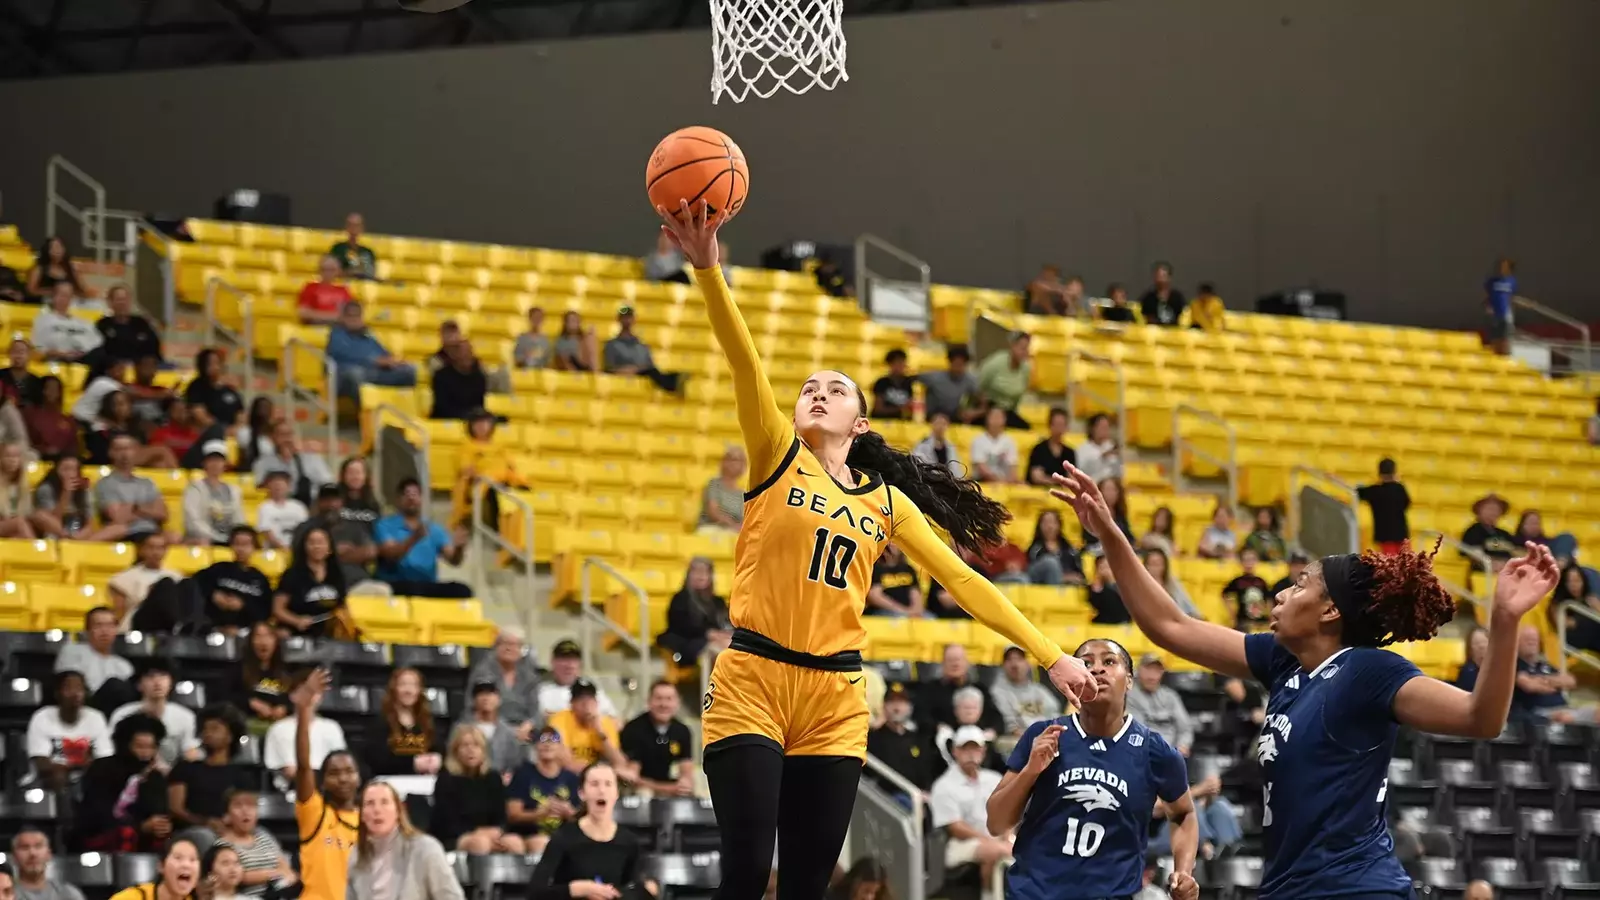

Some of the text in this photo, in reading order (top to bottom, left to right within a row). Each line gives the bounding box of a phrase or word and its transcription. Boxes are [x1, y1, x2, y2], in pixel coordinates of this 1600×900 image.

[807, 528, 858, 590] 10
[1057, 767, 1129, 798] NEVADA
[1062, 817, 1105, 857] 10
